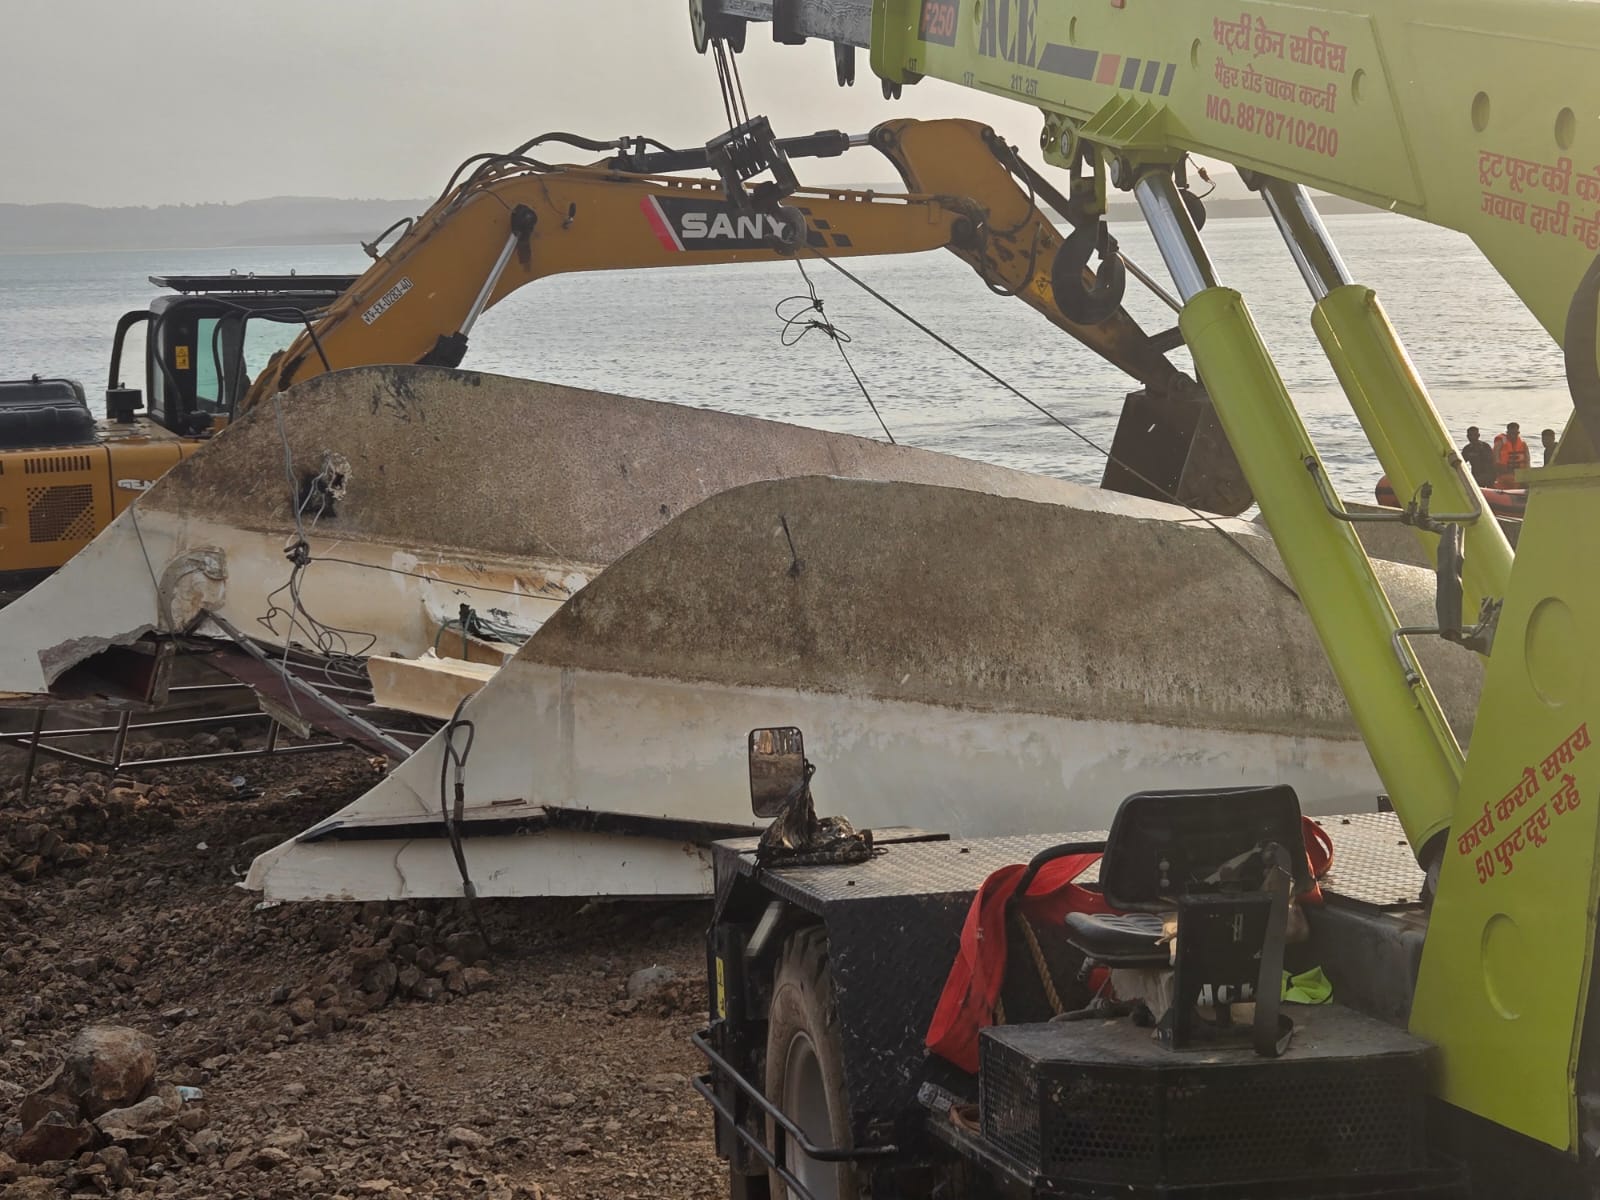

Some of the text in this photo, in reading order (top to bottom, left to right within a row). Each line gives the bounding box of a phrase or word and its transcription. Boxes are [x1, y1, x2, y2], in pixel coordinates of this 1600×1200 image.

[921, 2, 955, 37] F250
[978, 0, 1038, 68] ACE
[1254, 16, 1286, 59] क्रेन
[1289, 26, 1347, 73] सर्विस
[1241, 63, 1264, 94] रोड
[1299, 83, 1337, 113] कटनी
[1206, 94, 1339, 158] MO.8878710200
[1541, 157, 1572, 195] की
[681, 212, 787, 240] SANY
[1530, 200, 1570, 237] दारी
[1457, 721, 1592, 855] कार्य करते समय
[1475, 850, 1495, 885] 50
[1494, 825, 1526, 875] फुट
[1523, 803, 1551, 848] दूर
